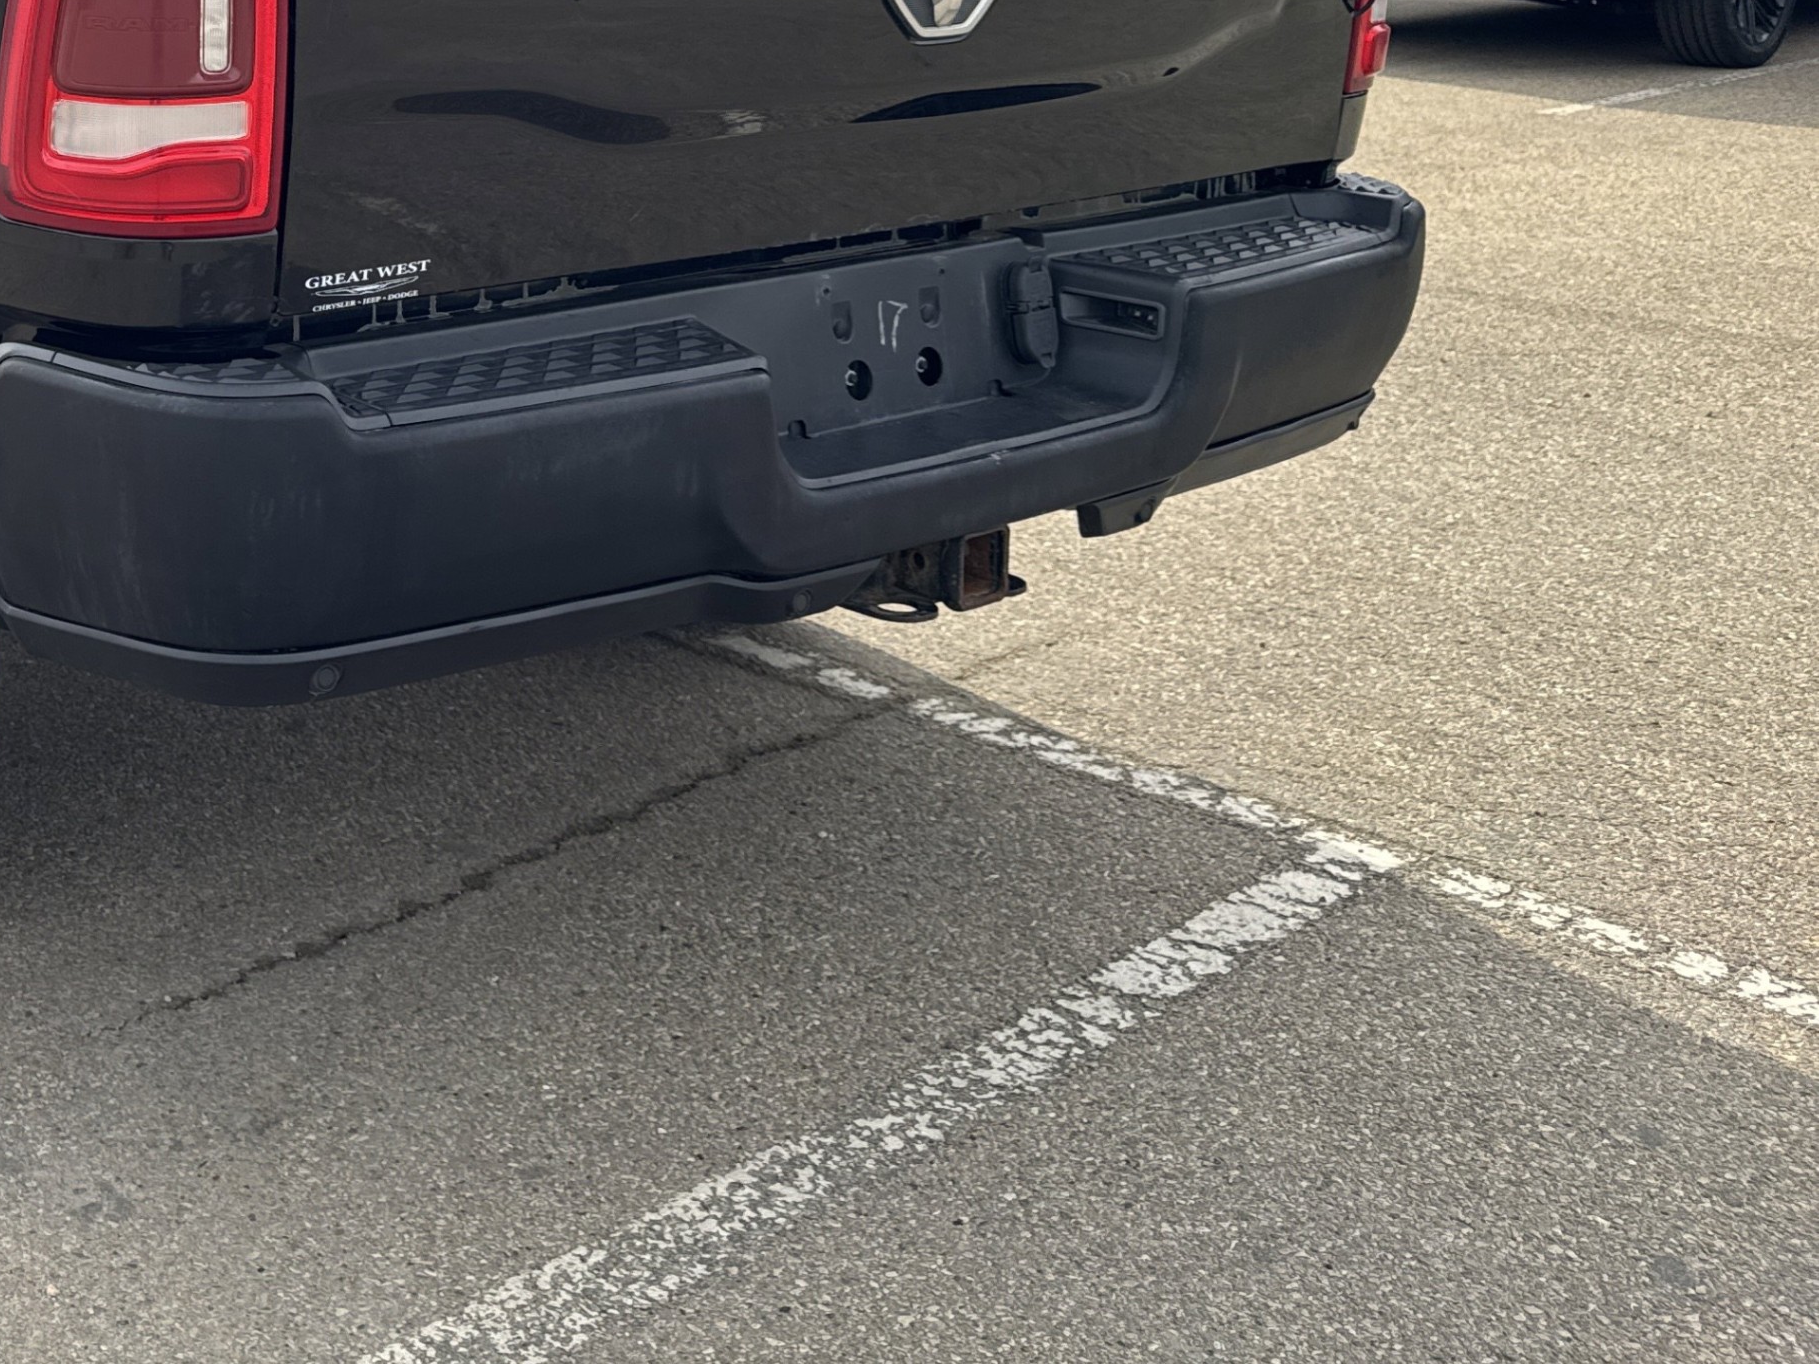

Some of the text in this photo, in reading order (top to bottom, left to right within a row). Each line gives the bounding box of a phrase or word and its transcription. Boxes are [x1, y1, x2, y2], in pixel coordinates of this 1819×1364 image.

[83, 15, 190, 32] RAM
[304, 259, 431, 290] GREAT WEST
[312, 289, 419, 313] CHRYSLER JEEP DODGE
[878, 300, 908, 352] 17
